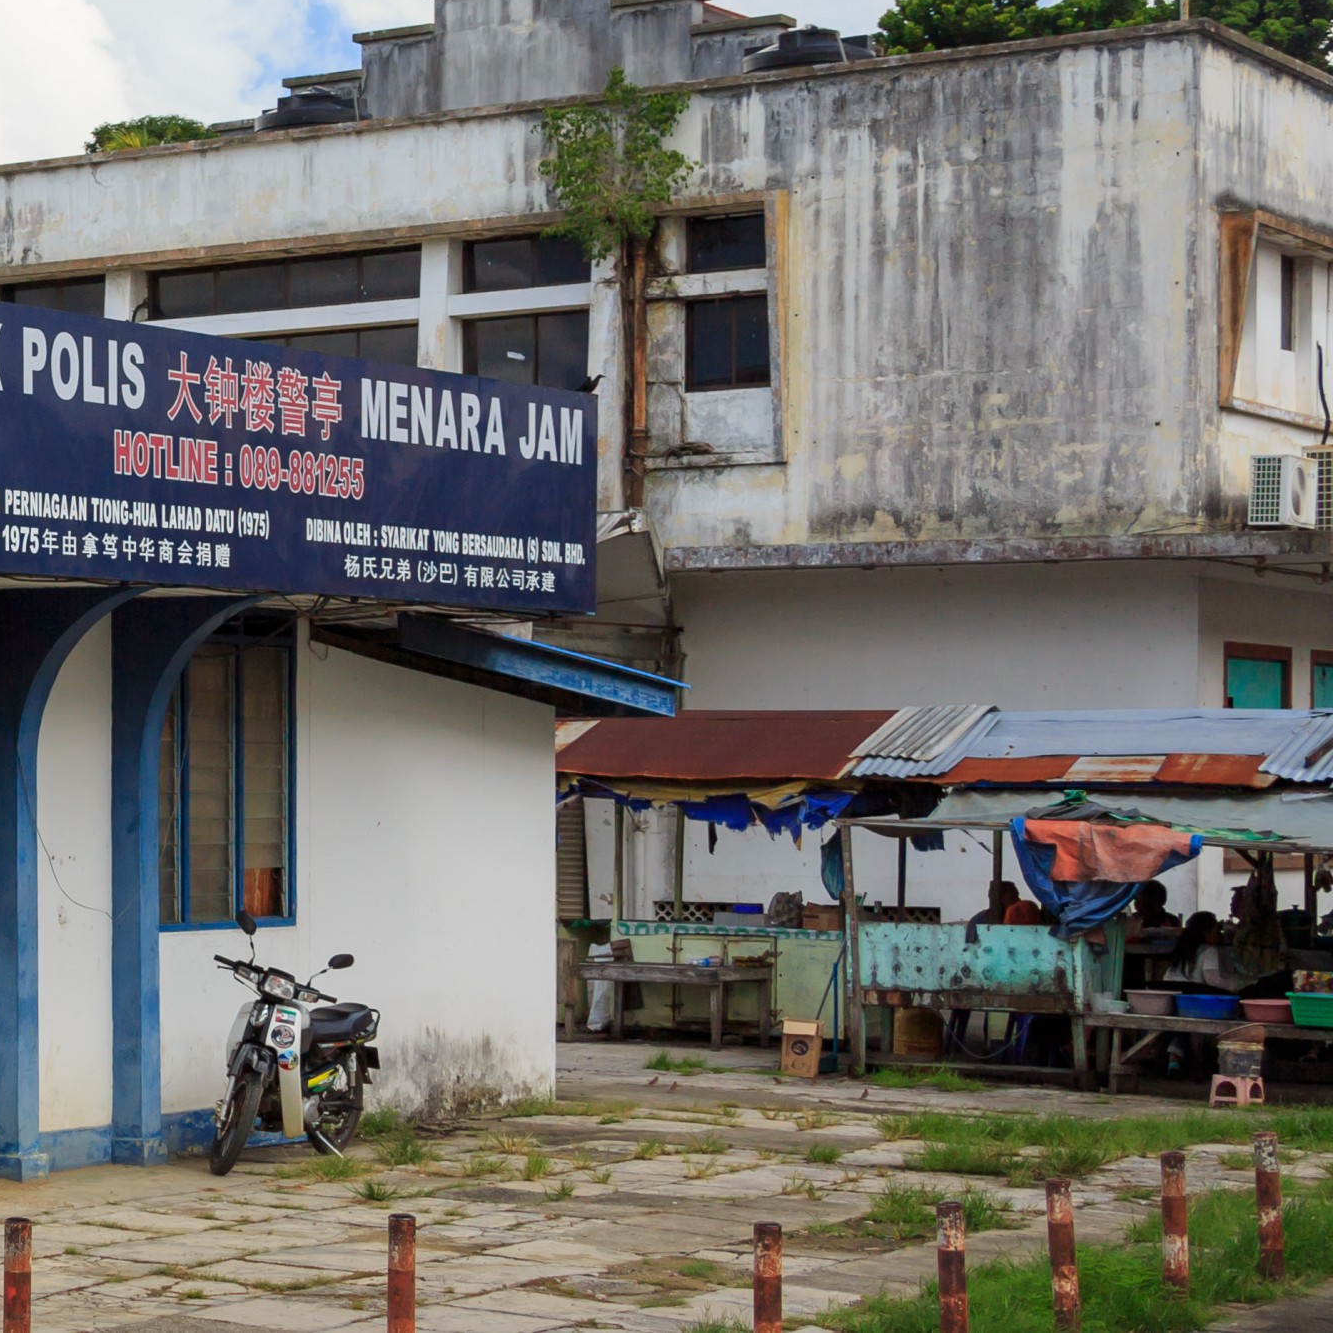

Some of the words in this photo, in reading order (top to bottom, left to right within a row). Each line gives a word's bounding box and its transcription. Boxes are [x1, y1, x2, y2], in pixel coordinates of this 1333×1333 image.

[22, 326, 146, 410] POLIS
[167, 350, 342, 442] 大钟楼警亭
[361, 378, 506, 456] MENARA
[519, 402, 583, 466] JAM
[113, 429, 218, 485] HOTLINE
[239, 443, 365, 501] 089-881255
[4, 488, 88, 522] PERNIAGAAN
[91, 497, 157, 528] TIONG-HUA
[161, 504, 202, 531] LAHAD
[205, 507, 235, 534] DATU
[237, 507, 270, 540] (1975)
[306, 518, 341, 545] DIBINA
[343, 521, 371, 547] OLEH
[380, 525, 430, 551] SYARIKAT
[432, 529, 460, 554] YONG
[462, 532, 525, 560] BERSAUDARA
[526, 536, 539, 564] (S)
[541, 542, 563, 564] SDN.
[565, 543, 586, 565] BHD.
